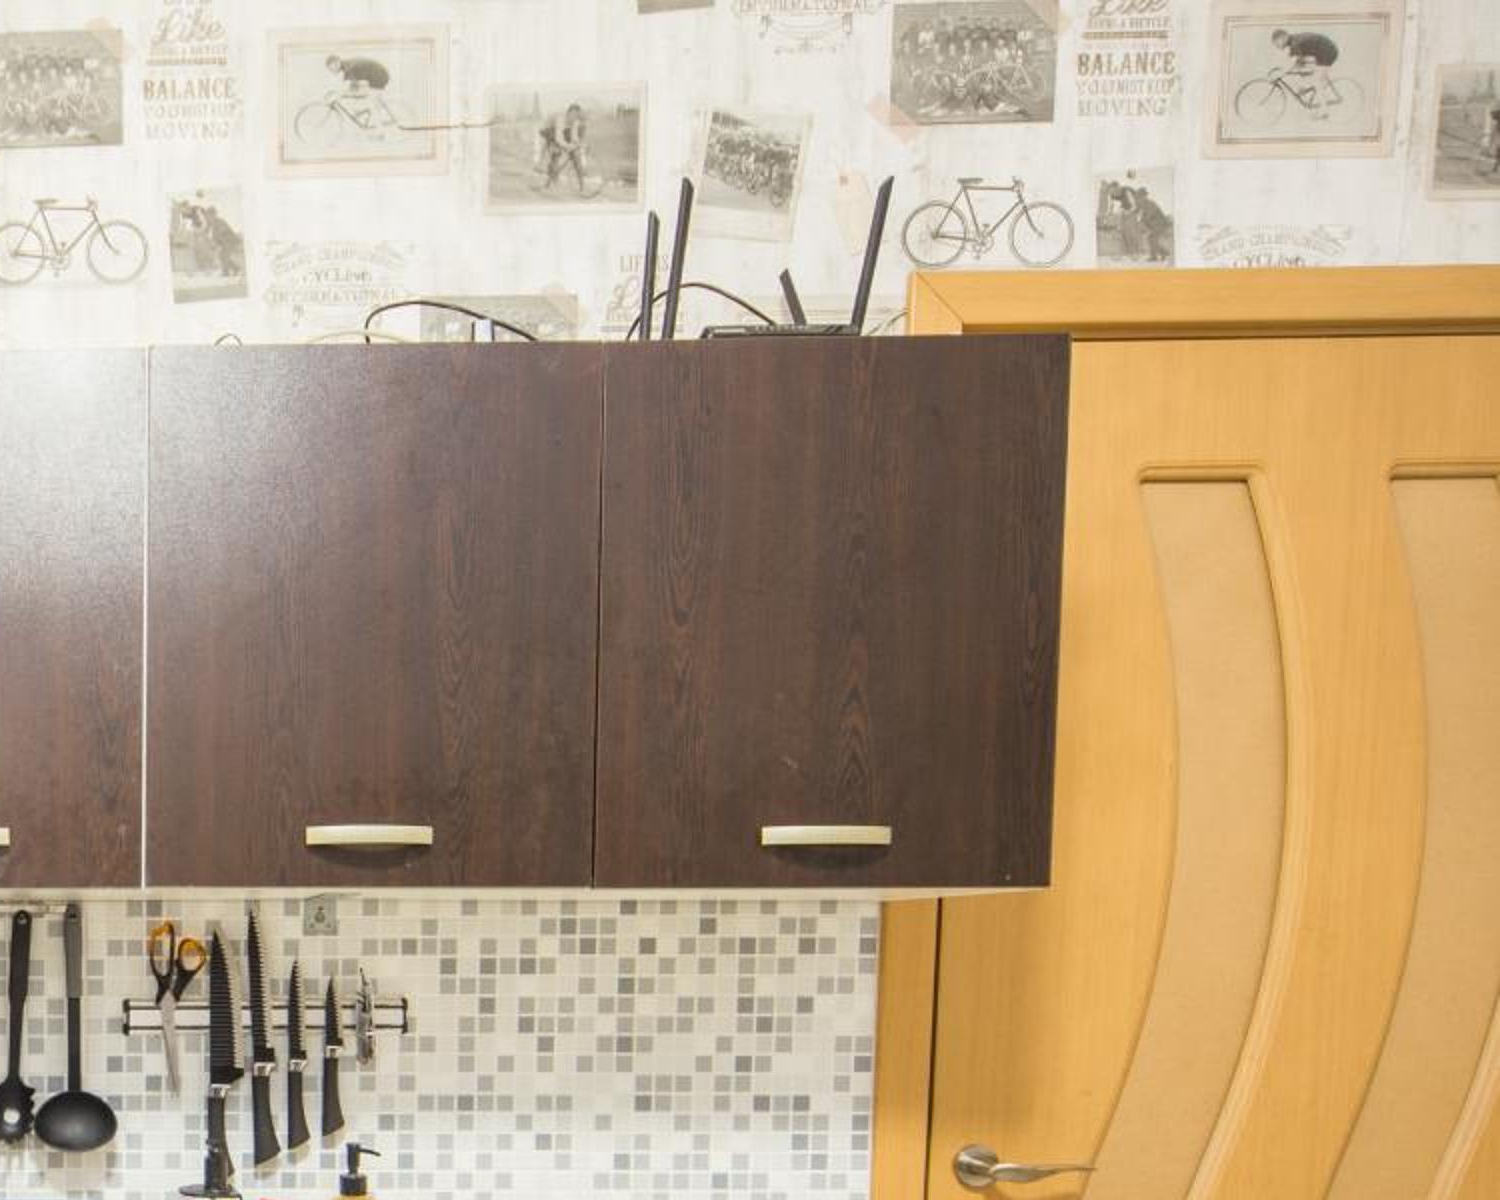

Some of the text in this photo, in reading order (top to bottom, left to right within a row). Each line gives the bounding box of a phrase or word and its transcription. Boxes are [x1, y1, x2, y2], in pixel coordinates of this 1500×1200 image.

[150, 7, 227, 47] Like
[1077, 51, 1176, 76] BALANCE
[143, 77, 237, 101] BALANCE
[1077, 96, 1168, 116] MOVING
[146, 121, 229, 141] MOVING
